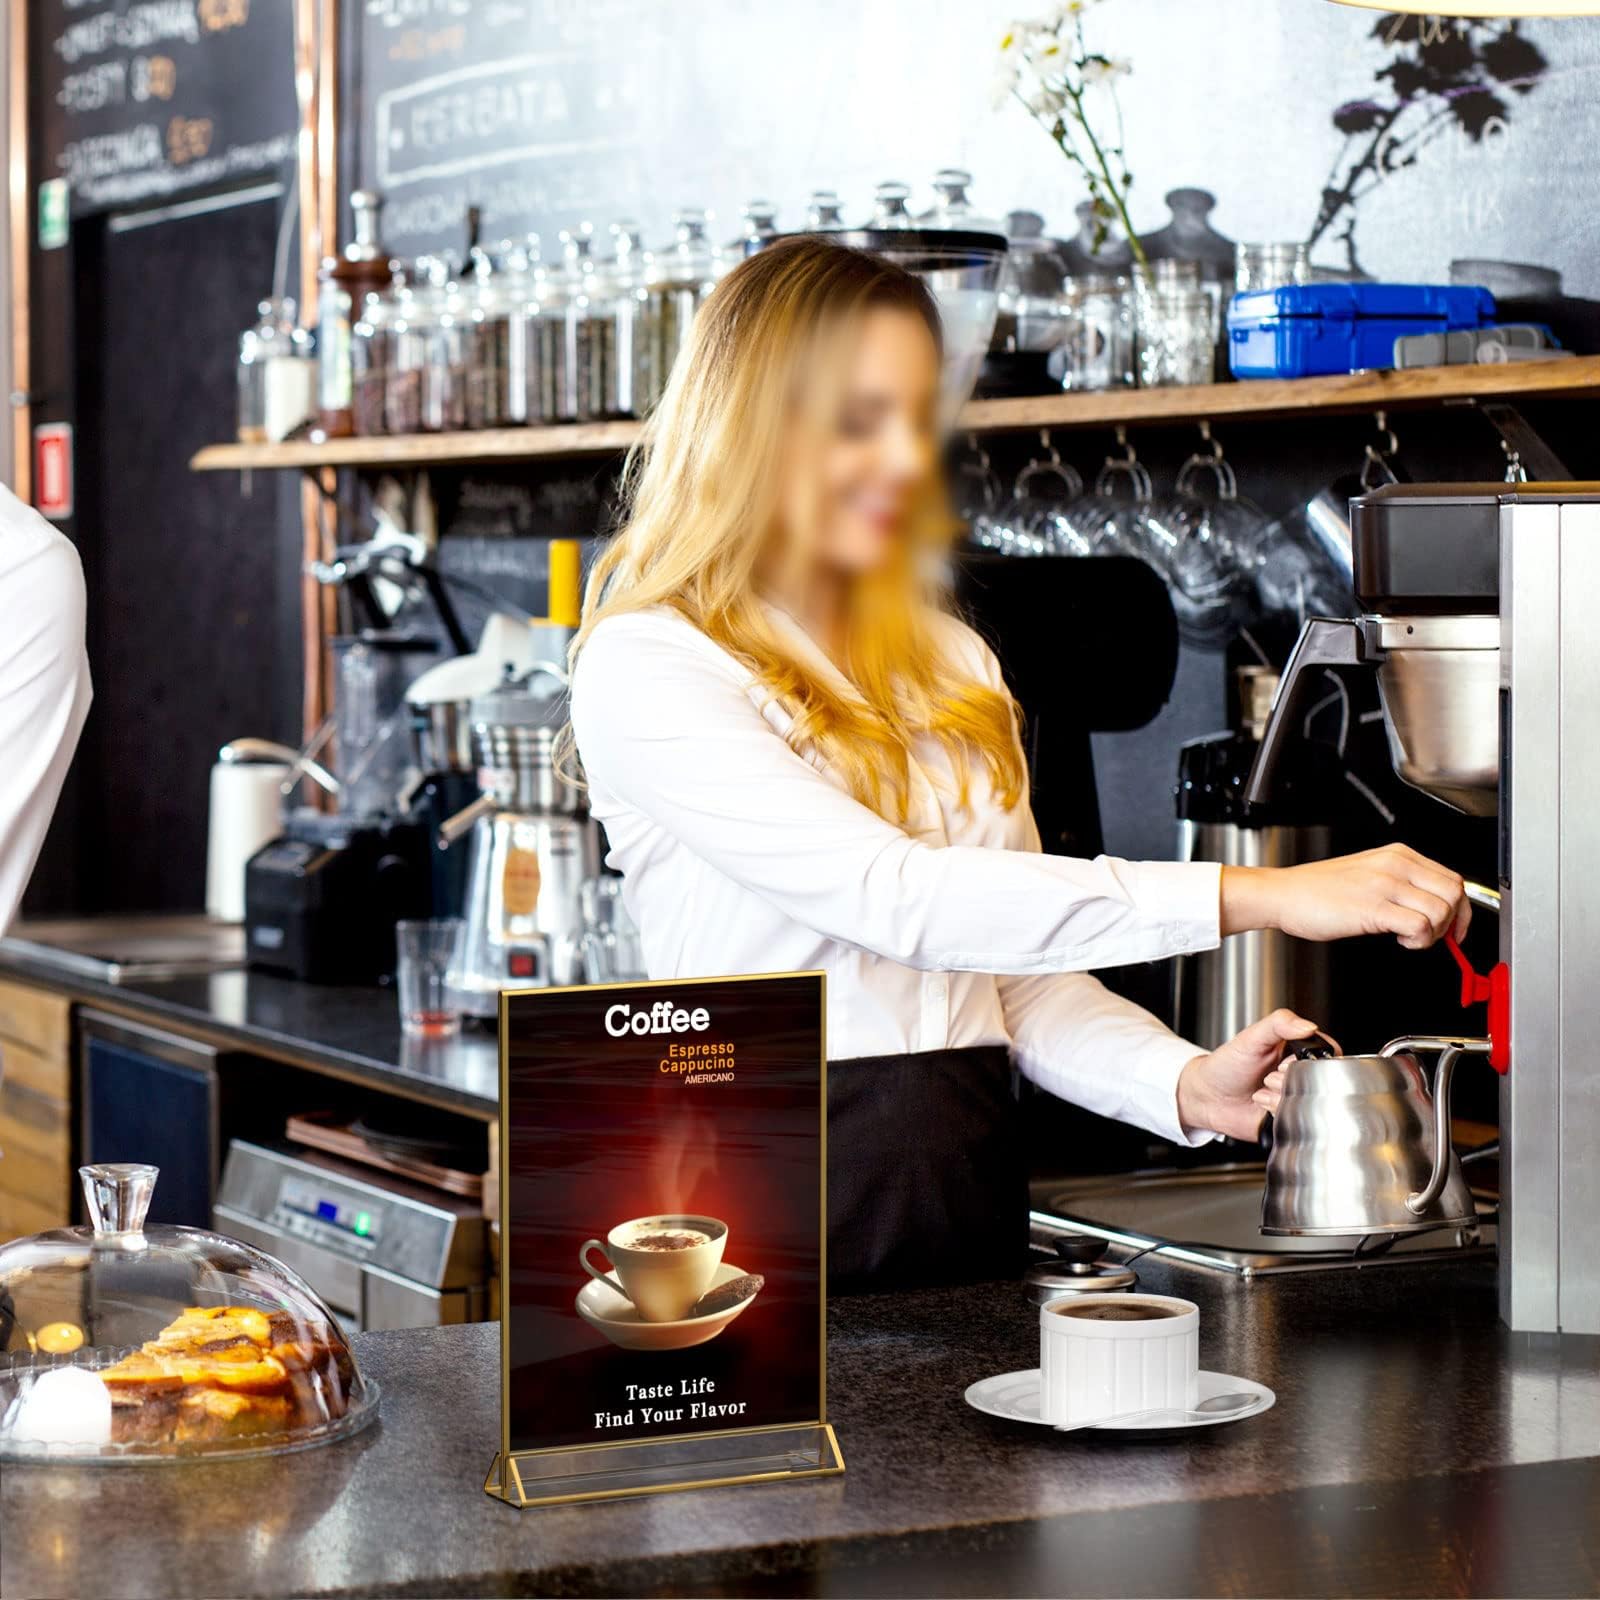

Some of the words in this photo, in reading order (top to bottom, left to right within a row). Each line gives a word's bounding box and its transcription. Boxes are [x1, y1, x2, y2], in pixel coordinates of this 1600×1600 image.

[604, 1001, 710, 1037] Coffee
[669, 1043, 735, 1059] Espresso
[660, 1057, 735, 1074] Cappucino
[684, 1072, 735, 1085] AMERICANO
[626, 1384, 673, 1401] Taste
[680, 1377, 715, 1396] Life
[594, 1409, 634, 1429] Find
[640, 1407, 683, 1424] Your
[690, 1401, 747, 1419] Flavor
